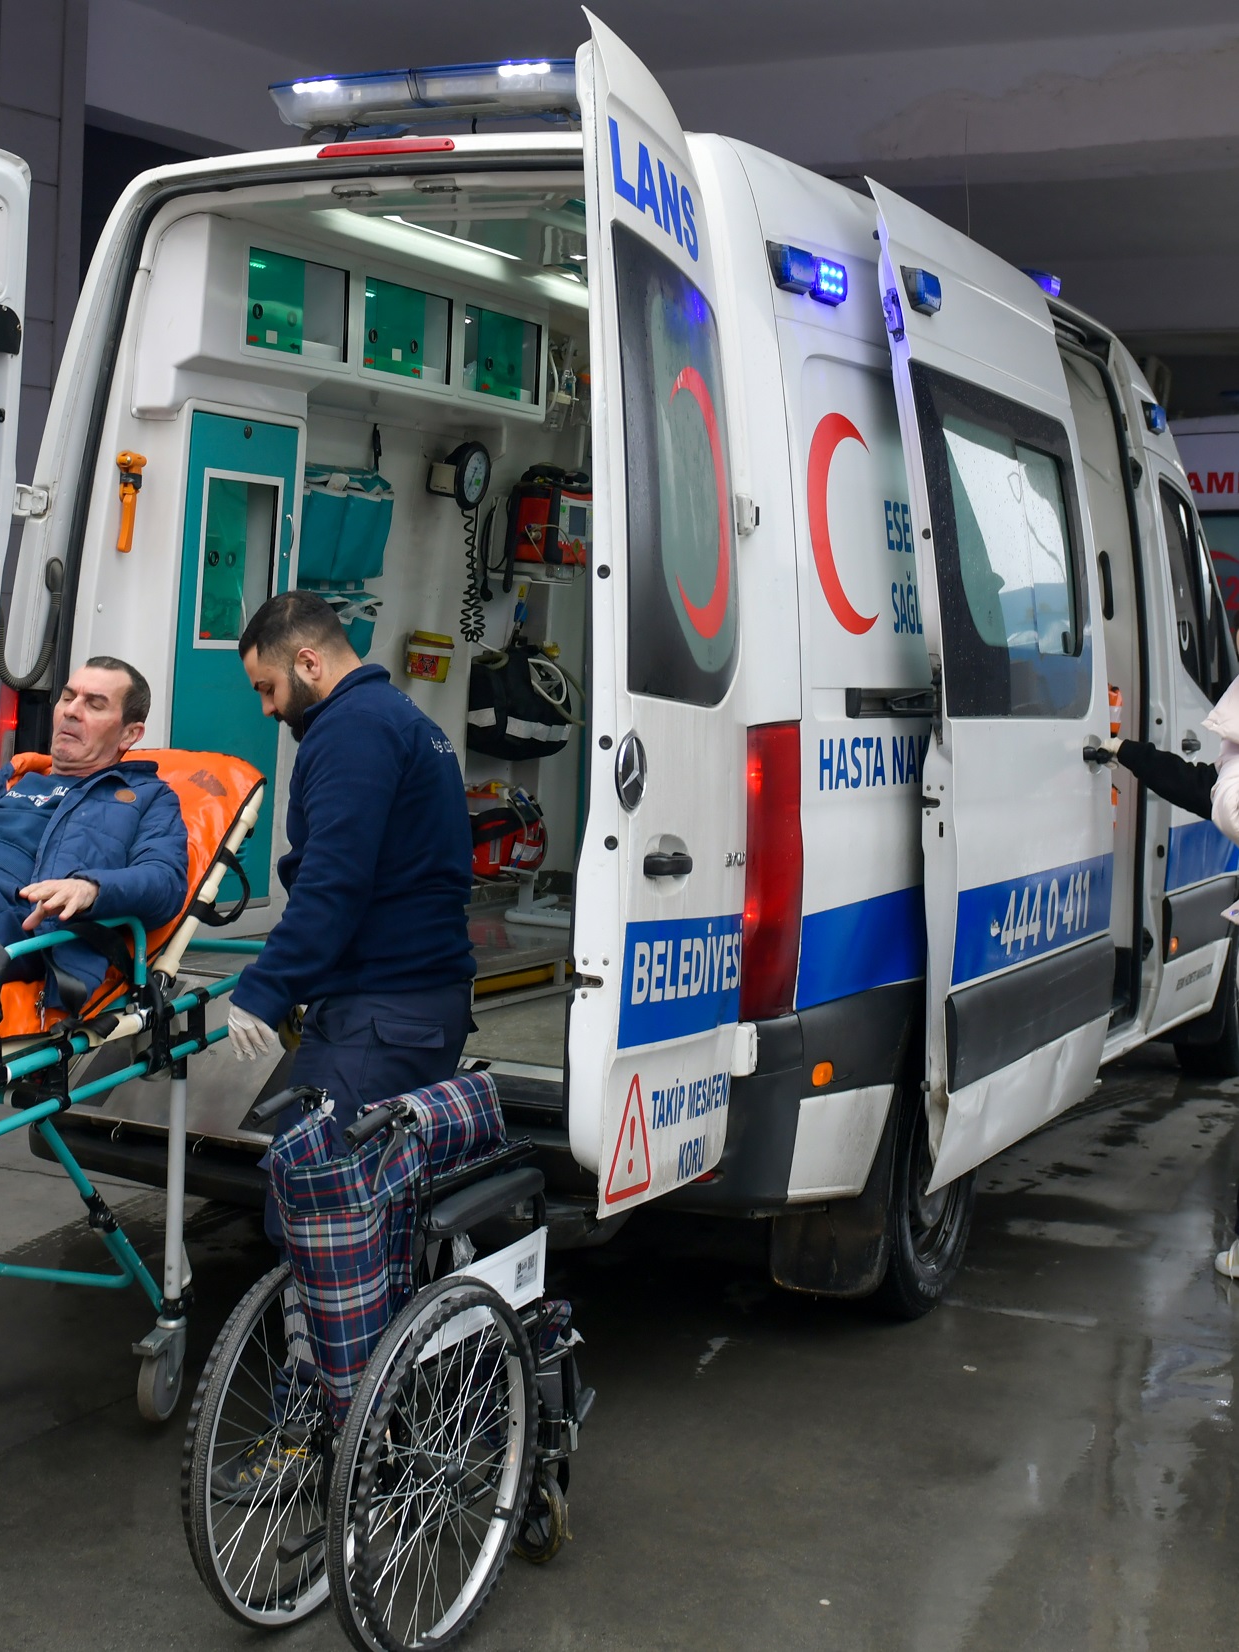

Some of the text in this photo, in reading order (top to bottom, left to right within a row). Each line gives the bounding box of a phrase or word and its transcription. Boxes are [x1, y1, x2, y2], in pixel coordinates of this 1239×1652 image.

[608, 115, 699, 263] LANS
[1187, 471, 1239, 494] AM
[884, 500, 916, 554] ESE
[819, 736, 886, 791] HASTA
[1000, 870, 1090, 956] 444 0 411
[631, 919, 743, 1006] BELEDİYESİ
[652, 1078, 686, 1130] TAKİP
[677, 1134, 706, 1182] KORU
